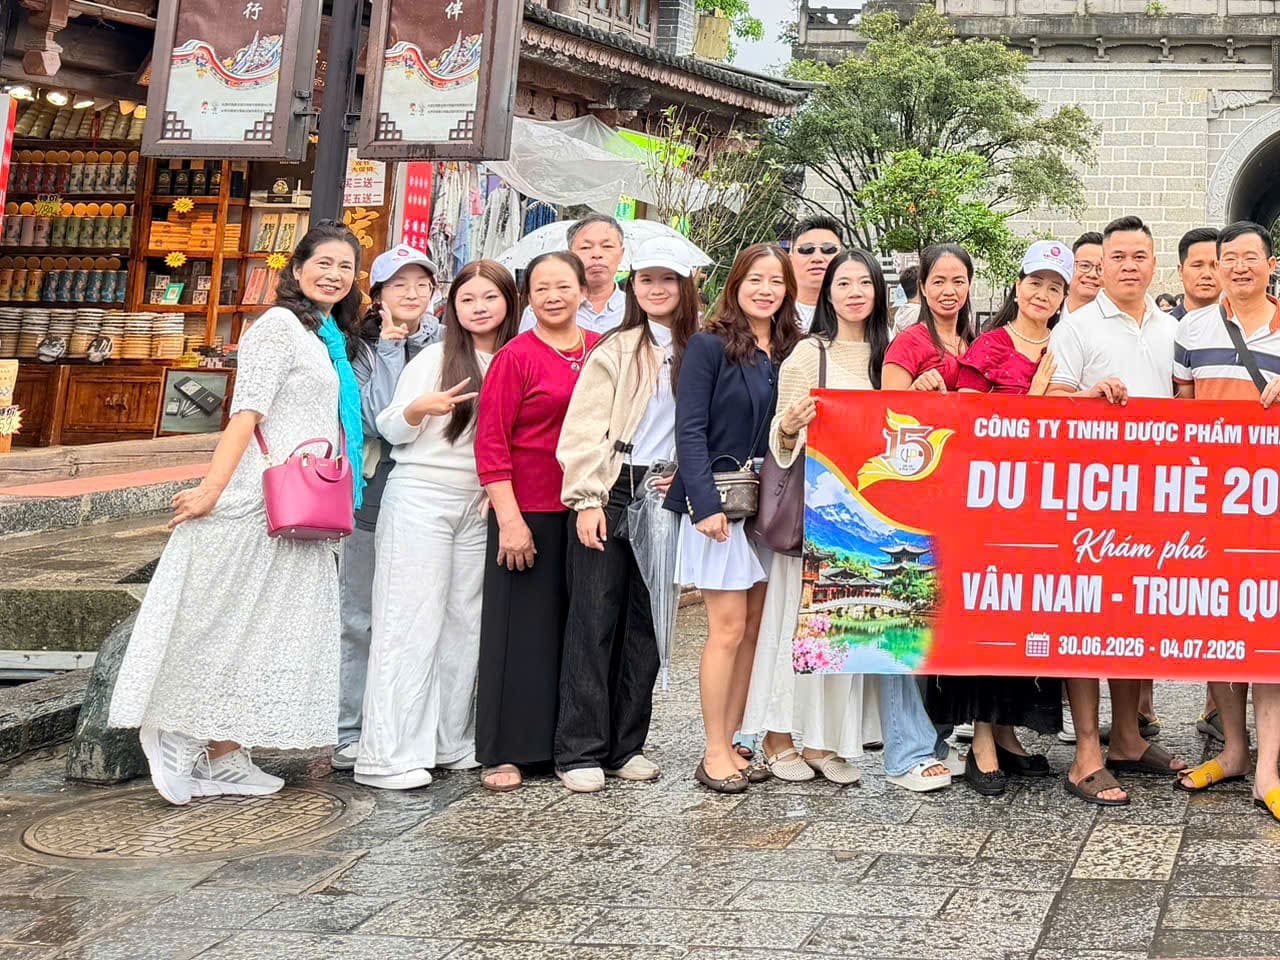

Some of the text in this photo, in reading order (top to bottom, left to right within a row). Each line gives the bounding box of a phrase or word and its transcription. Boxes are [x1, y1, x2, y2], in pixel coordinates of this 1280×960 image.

[974, 414, 1031, 439] CÔNG
[1037, 419, 1061, 439] TY
[1066, 420, 1119, 440] TNHH
[1124, 421, 1179, 446] DƯỢC
[1184, 417, 1242, 444] PHẨM
[966, 460, 1028, 509] DU
[1040, 462, 1140, 521] LỊCH
[1153, 456, 1209, 514] HÈ
[1072, 527, 1209, 570] Khám phá
[962, 565, 1024, 612] VÂN
[1031, 573, 1103, 613] NAM
[1111, 592, 1124, 602] -
[1132, 576, 1229, 617] TRUNG
[1057, 635, 1145, 657] 30.06.2026
[1160, 638, 1246, 660] 04.07.2026
